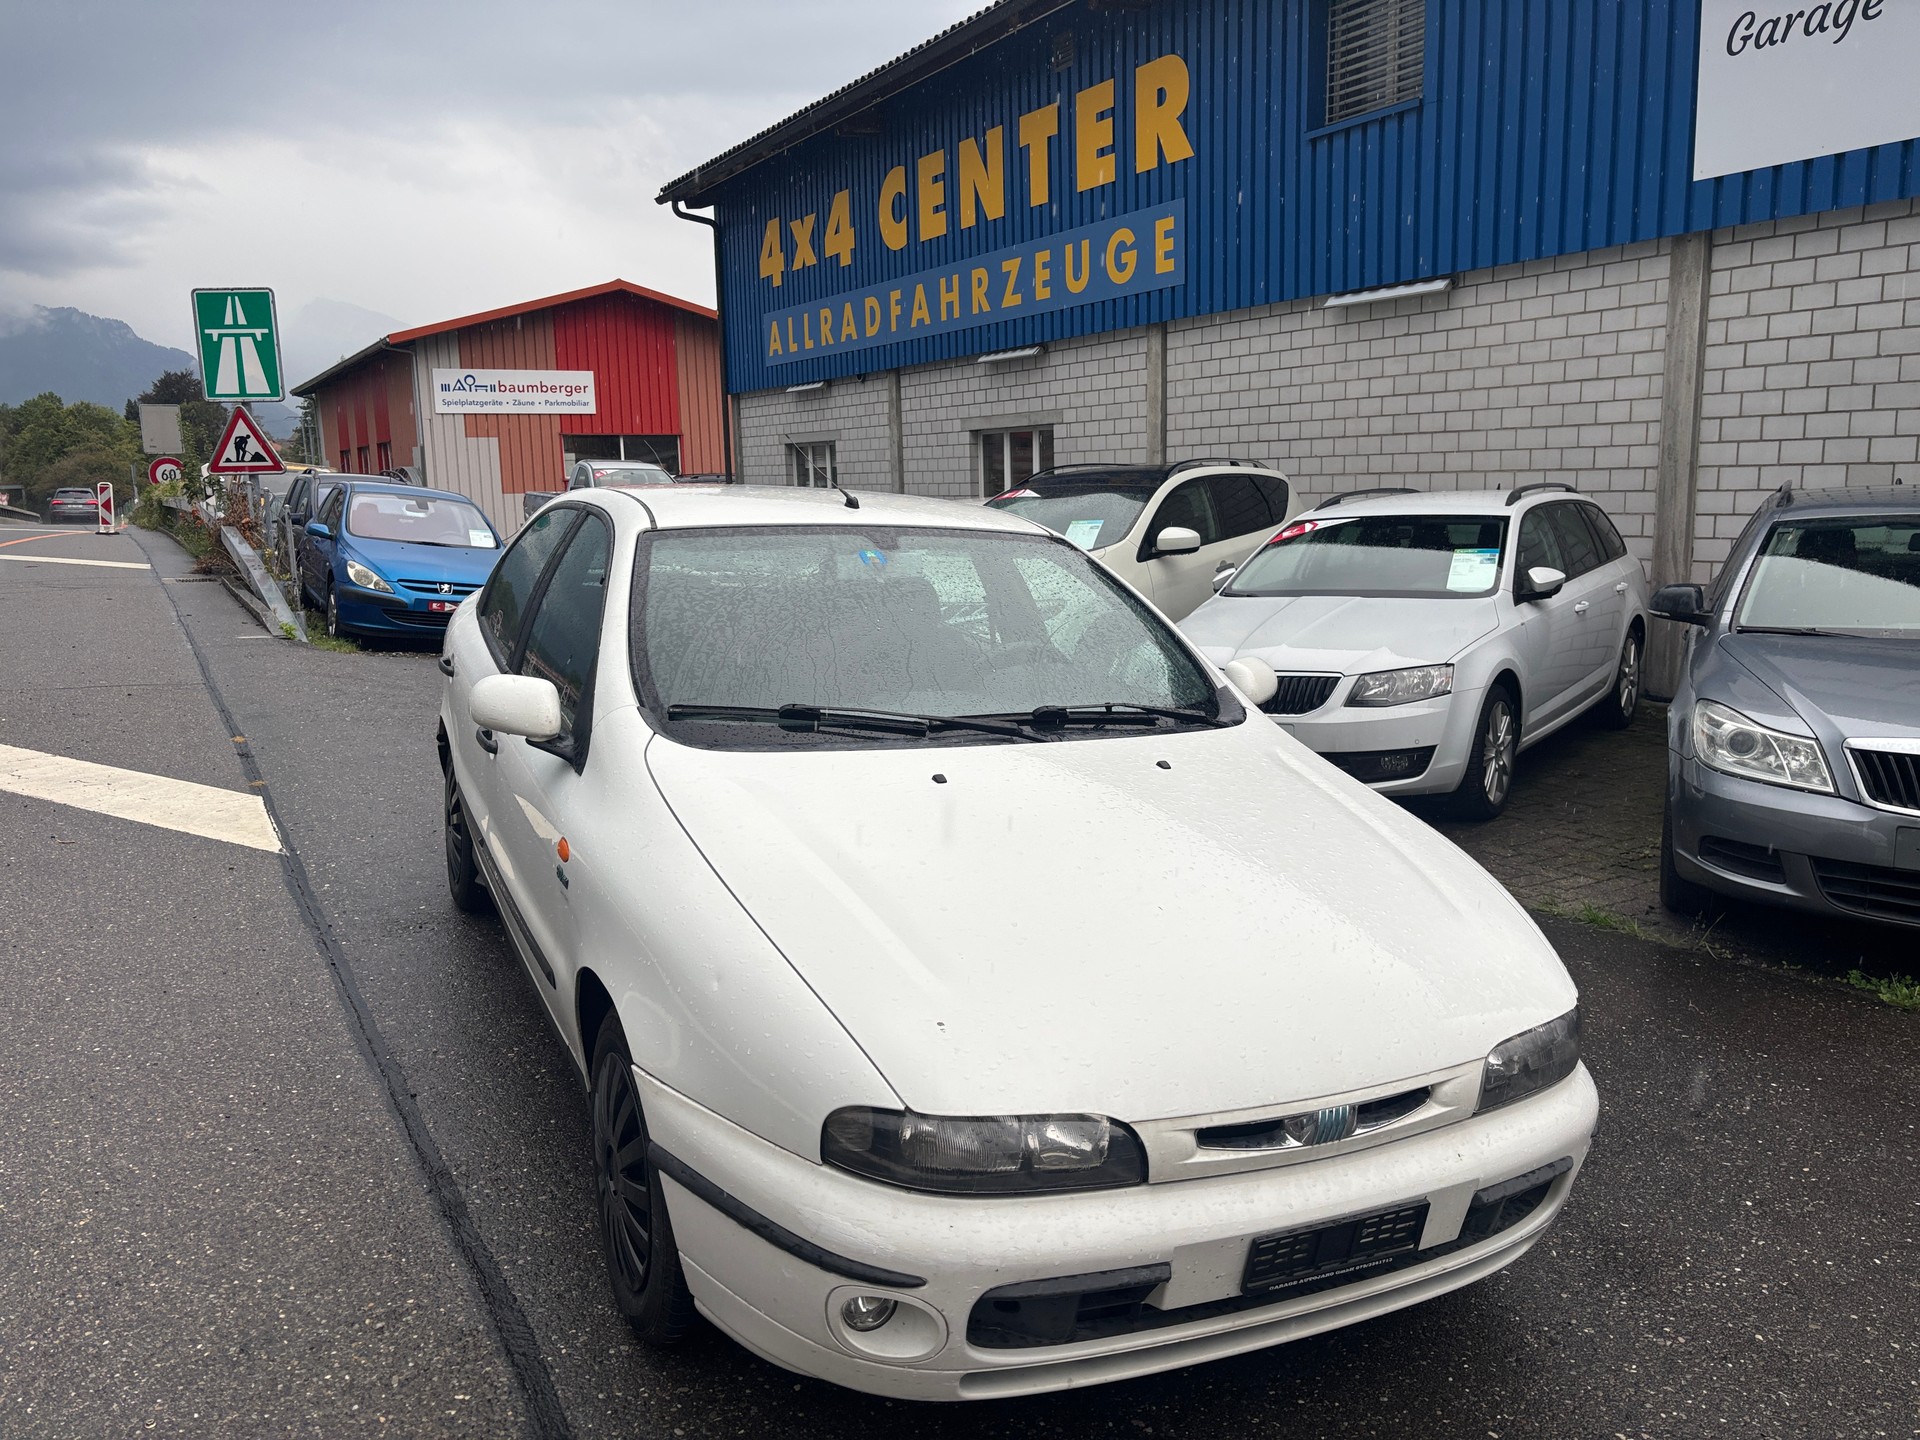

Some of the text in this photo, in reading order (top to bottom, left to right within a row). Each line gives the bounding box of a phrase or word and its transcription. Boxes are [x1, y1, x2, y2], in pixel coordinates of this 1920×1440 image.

[1726, 0, 1884, 57] Garage
[759, 53, 1195, 288] 4x4 CENTER
[768, 215, 1176, 357] ALLRADFAHRZEUGE
[497, 380, 589, 397] baumberger
[441, 398, 590, 408] Spielplatzgeräte Zäune Parkmobiliar
[161, 468, 177, 481] 60
[1268, 1280, 1298, 1291] GARAGE
